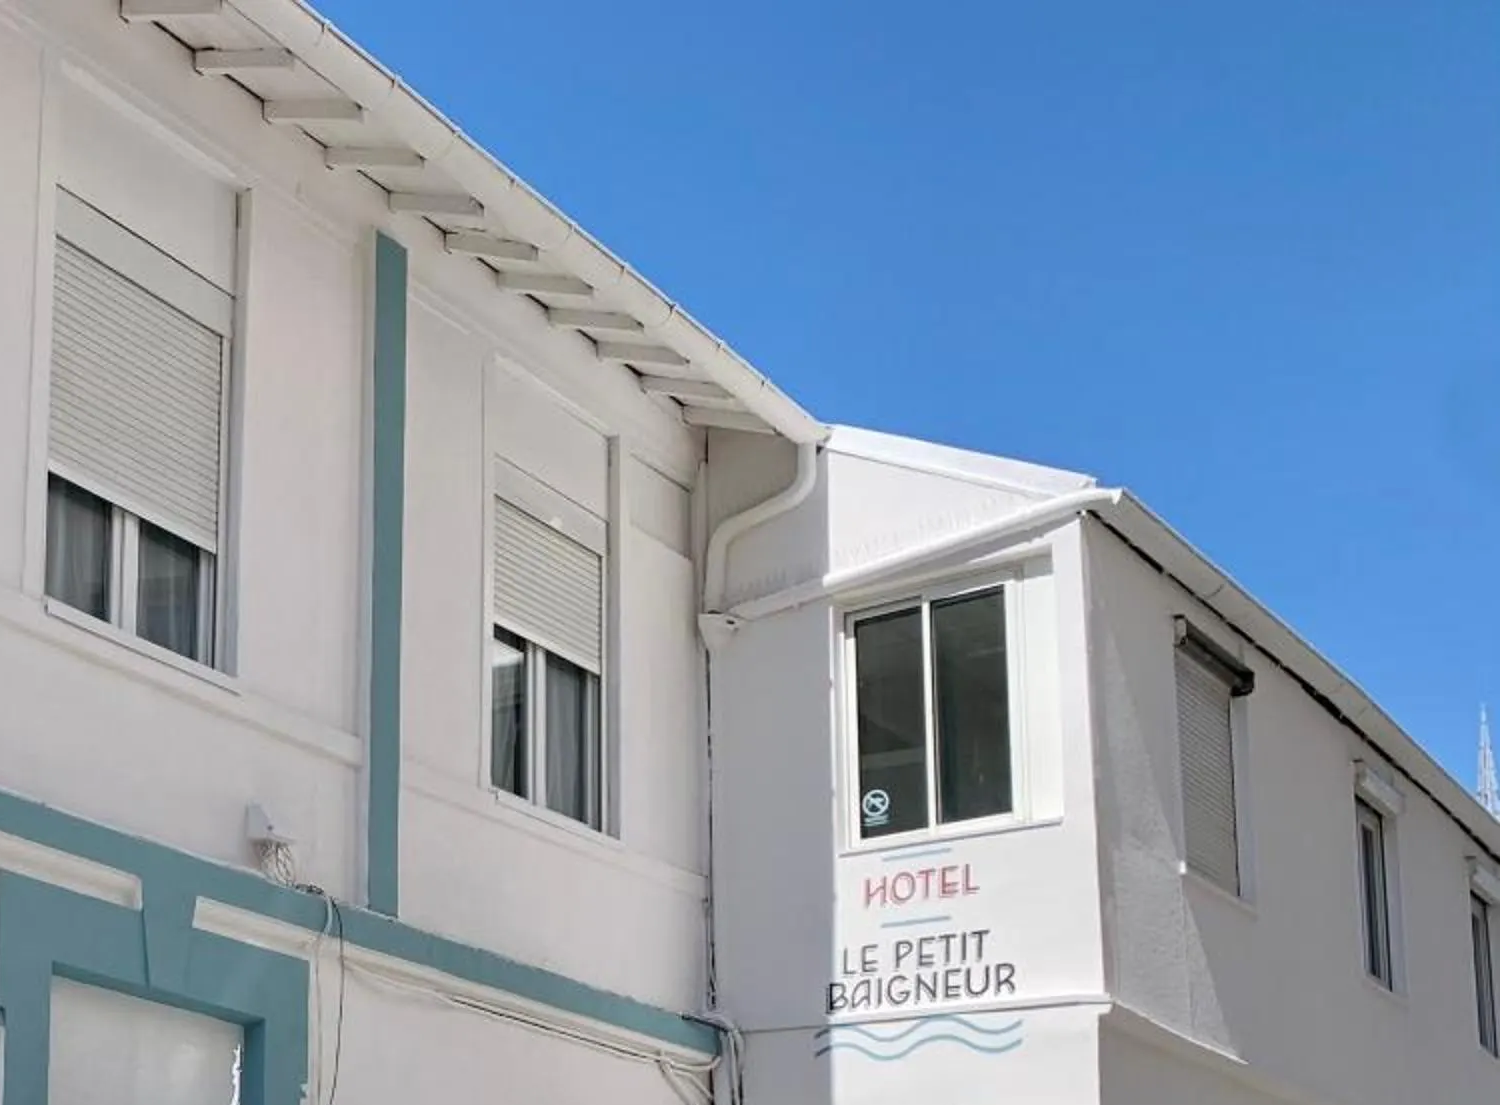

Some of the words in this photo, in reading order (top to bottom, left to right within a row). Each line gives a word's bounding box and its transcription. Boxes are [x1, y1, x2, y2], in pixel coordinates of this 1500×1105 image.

[864, 864, 980, 906] HOTEL
[842, 945, 878, 976] LE
[894, 930, 990, 969] PETIT
[826, 963, 1016, 1013] BAIGNEUR
